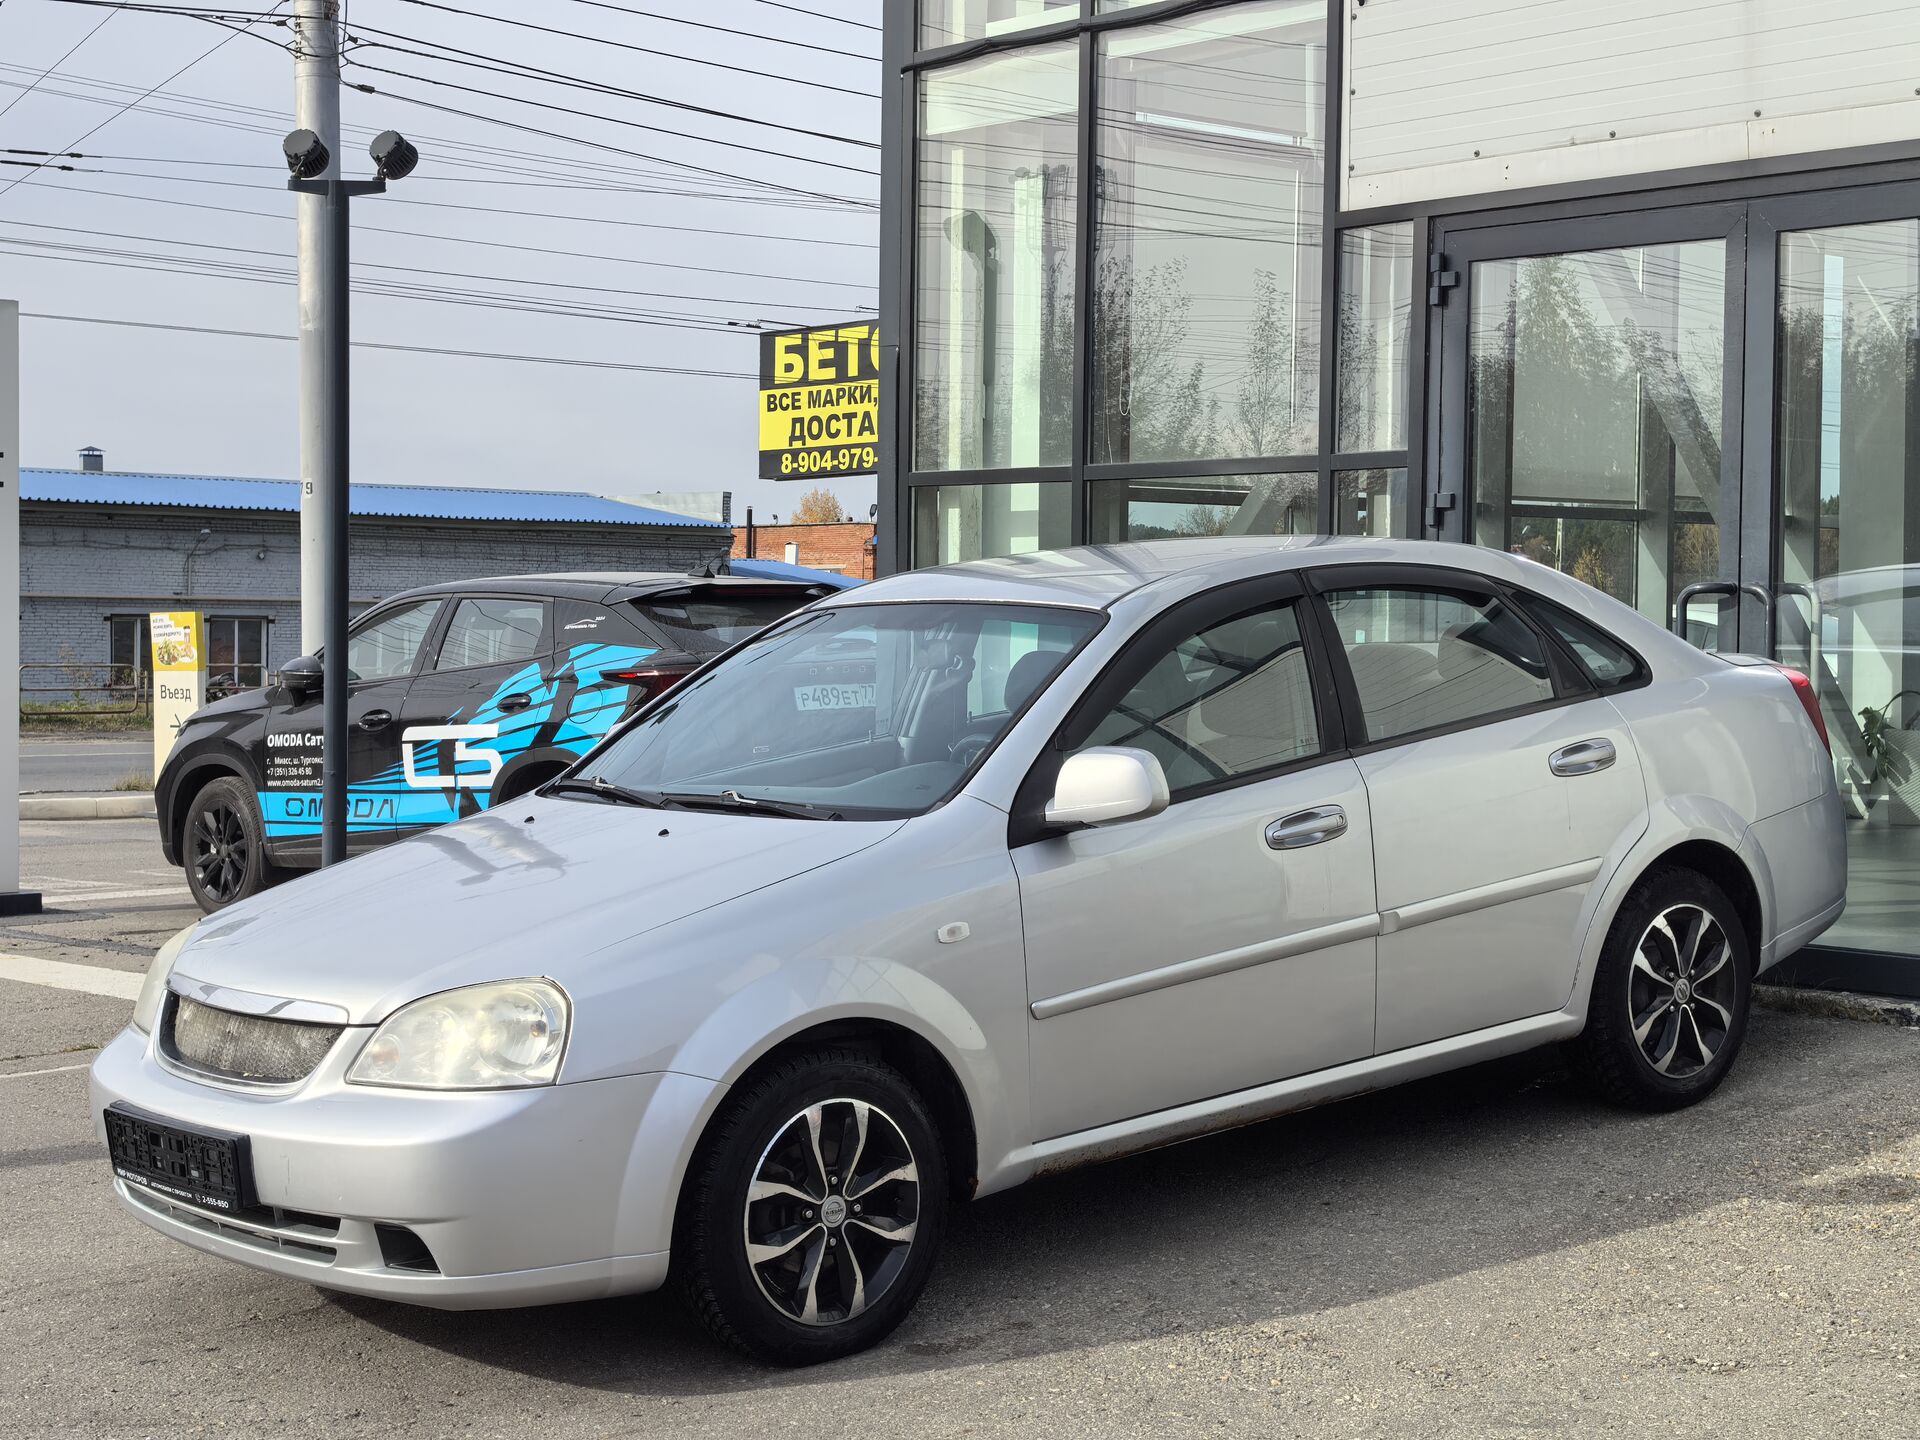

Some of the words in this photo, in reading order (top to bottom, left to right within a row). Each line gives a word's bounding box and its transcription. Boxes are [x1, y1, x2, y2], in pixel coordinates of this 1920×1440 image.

[774, 325, 879, 385] БЕТ
[767, 392, 801, 412] ВСЕ
[808, 385, 878, 409] МАРКИ,
[781, 447, 878, 474] 8-904-979-
[160, 684, 192, 702] Въезд
[267, 733, 303, 748] OMODA
[274, 757, 292, 766] Миасс,
[274, 767, 288, 777] (351)
[285, 798, 394, 819] OMDA
[202, 1195, 229, 1209] 2-555-850
